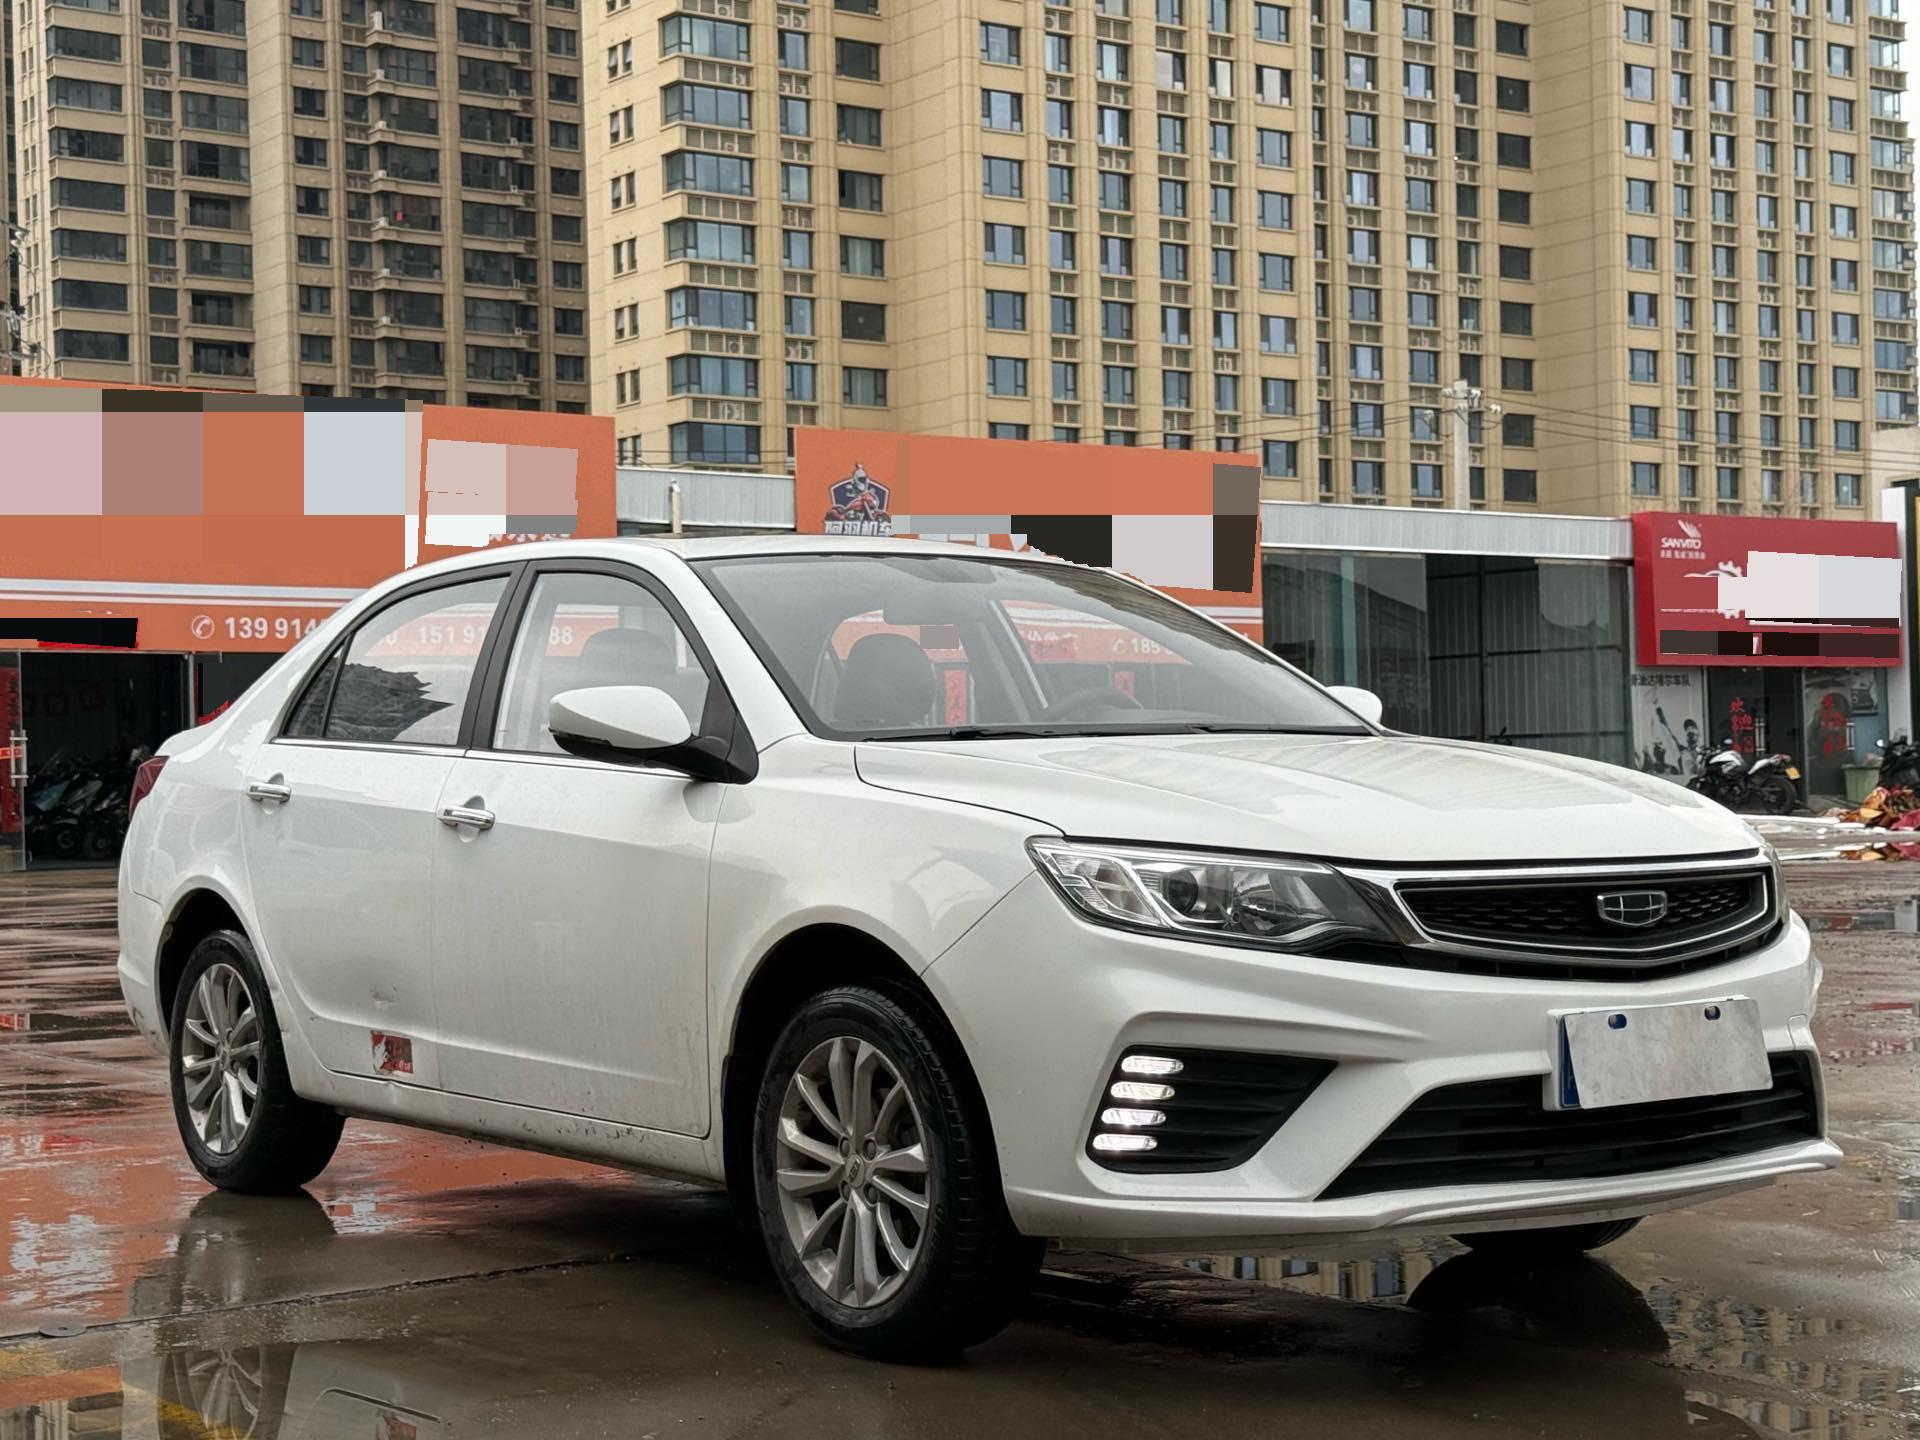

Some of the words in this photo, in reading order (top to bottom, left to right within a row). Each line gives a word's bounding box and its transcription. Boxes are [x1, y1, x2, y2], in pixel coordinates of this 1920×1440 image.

[1660, 536, 1702, 550] SANVITO
[225, 616, 269, 639] 139
[274, 617, 327, 639] 914
